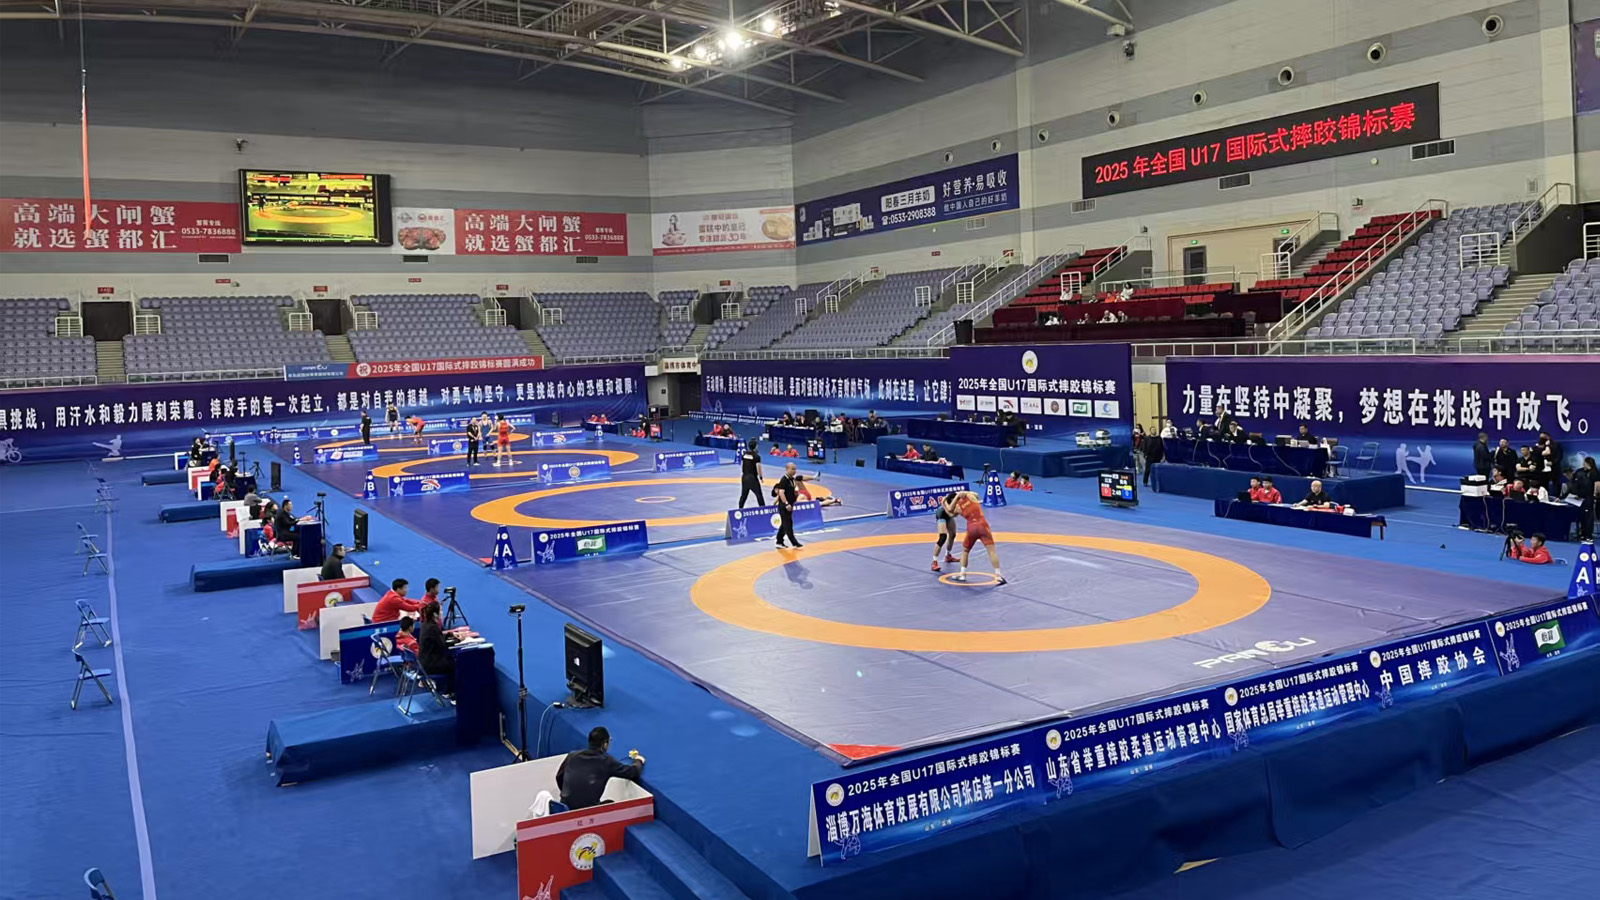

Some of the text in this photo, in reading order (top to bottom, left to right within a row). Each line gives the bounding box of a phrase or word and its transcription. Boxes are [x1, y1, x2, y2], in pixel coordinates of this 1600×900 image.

[1095, 101, 1416, 184] 2025 年全国 U17 国际式摔跤锦标赛
[884, 189, 931, 210] 阳春三月羊奶
[13, 203, 178, 227] 高端大闸蟹
[465, 213, 582, 233] 高端大闸蟹
[12, 227, 178, 250] 就选蟹都汇
[181, 227, 236, 235] 0533-7836888
[465, 234, 582, 253] 就选蟹都汇
[958, 378, 1117, 395] 2025年全国U17国际式摔跤锦标赛
[367, 481, 375, 491] B
[987, 484, 1002, 496] B B
[502, 543, 513, 557] A
[1576, 566, 1590, 585] A
[1379, 646, 1486, 691] 中国摔跤协会
[1063, 698, 1210, 742] 2025年全国U17国际式摔跤锦标赛
[1046, 718, 1222, 780] 山东省举重摔跤柔道运动管理中心
[847, 743, 1021, 796] 2025年全国U17国际式摔跤锦标赛
[825, 764, 1036, 843] 淄博万海体育发展有限公司张店第一分公司
